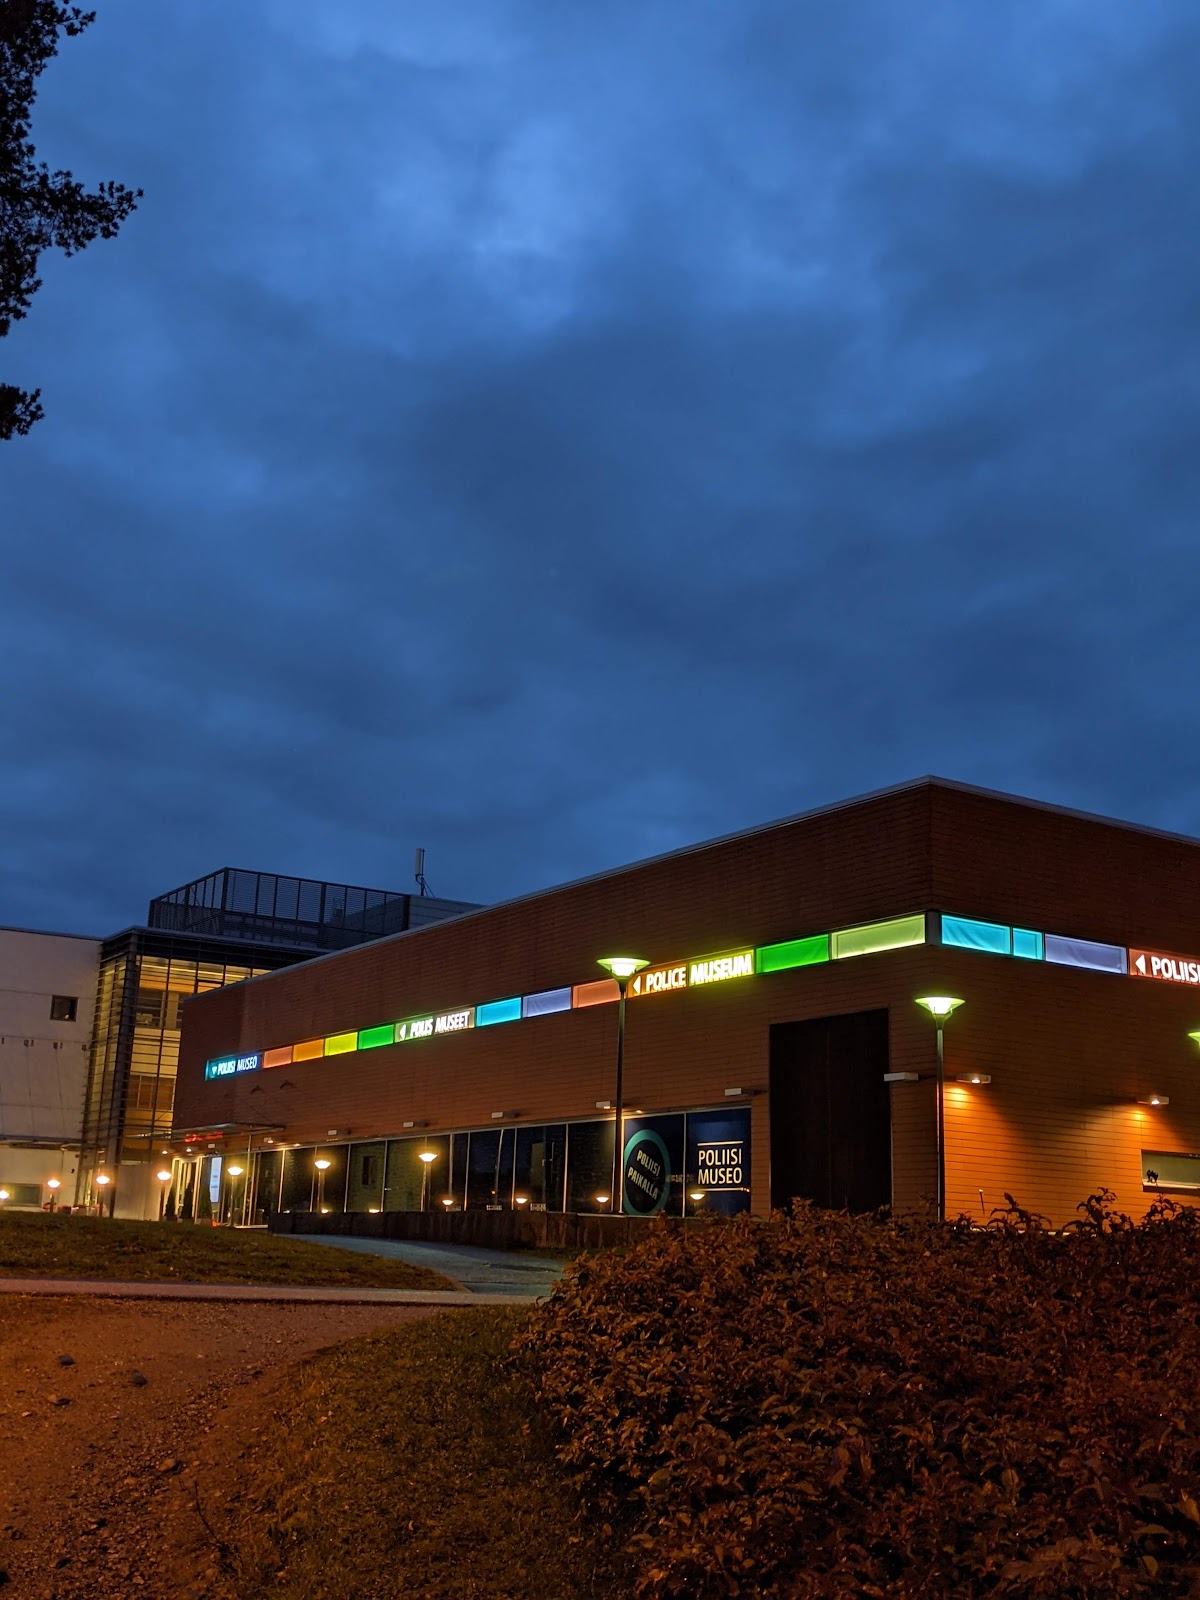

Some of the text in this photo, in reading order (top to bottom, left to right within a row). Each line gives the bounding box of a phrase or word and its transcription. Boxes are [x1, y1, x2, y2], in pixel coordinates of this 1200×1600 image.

[645, 953, 752, 992] POLICE MUSEUM
[434, 1011, 470, 1033] MUSEET
[236, 1055, 258, 1072] MUSEO
[636, 1149, 661, 1177] POLIISI
[697, 1148, 742, 1166] POLIISI
[627, 1166, 659, 1200] PAIKALLA
[697, 1167, 743, 1184] MUSEO
